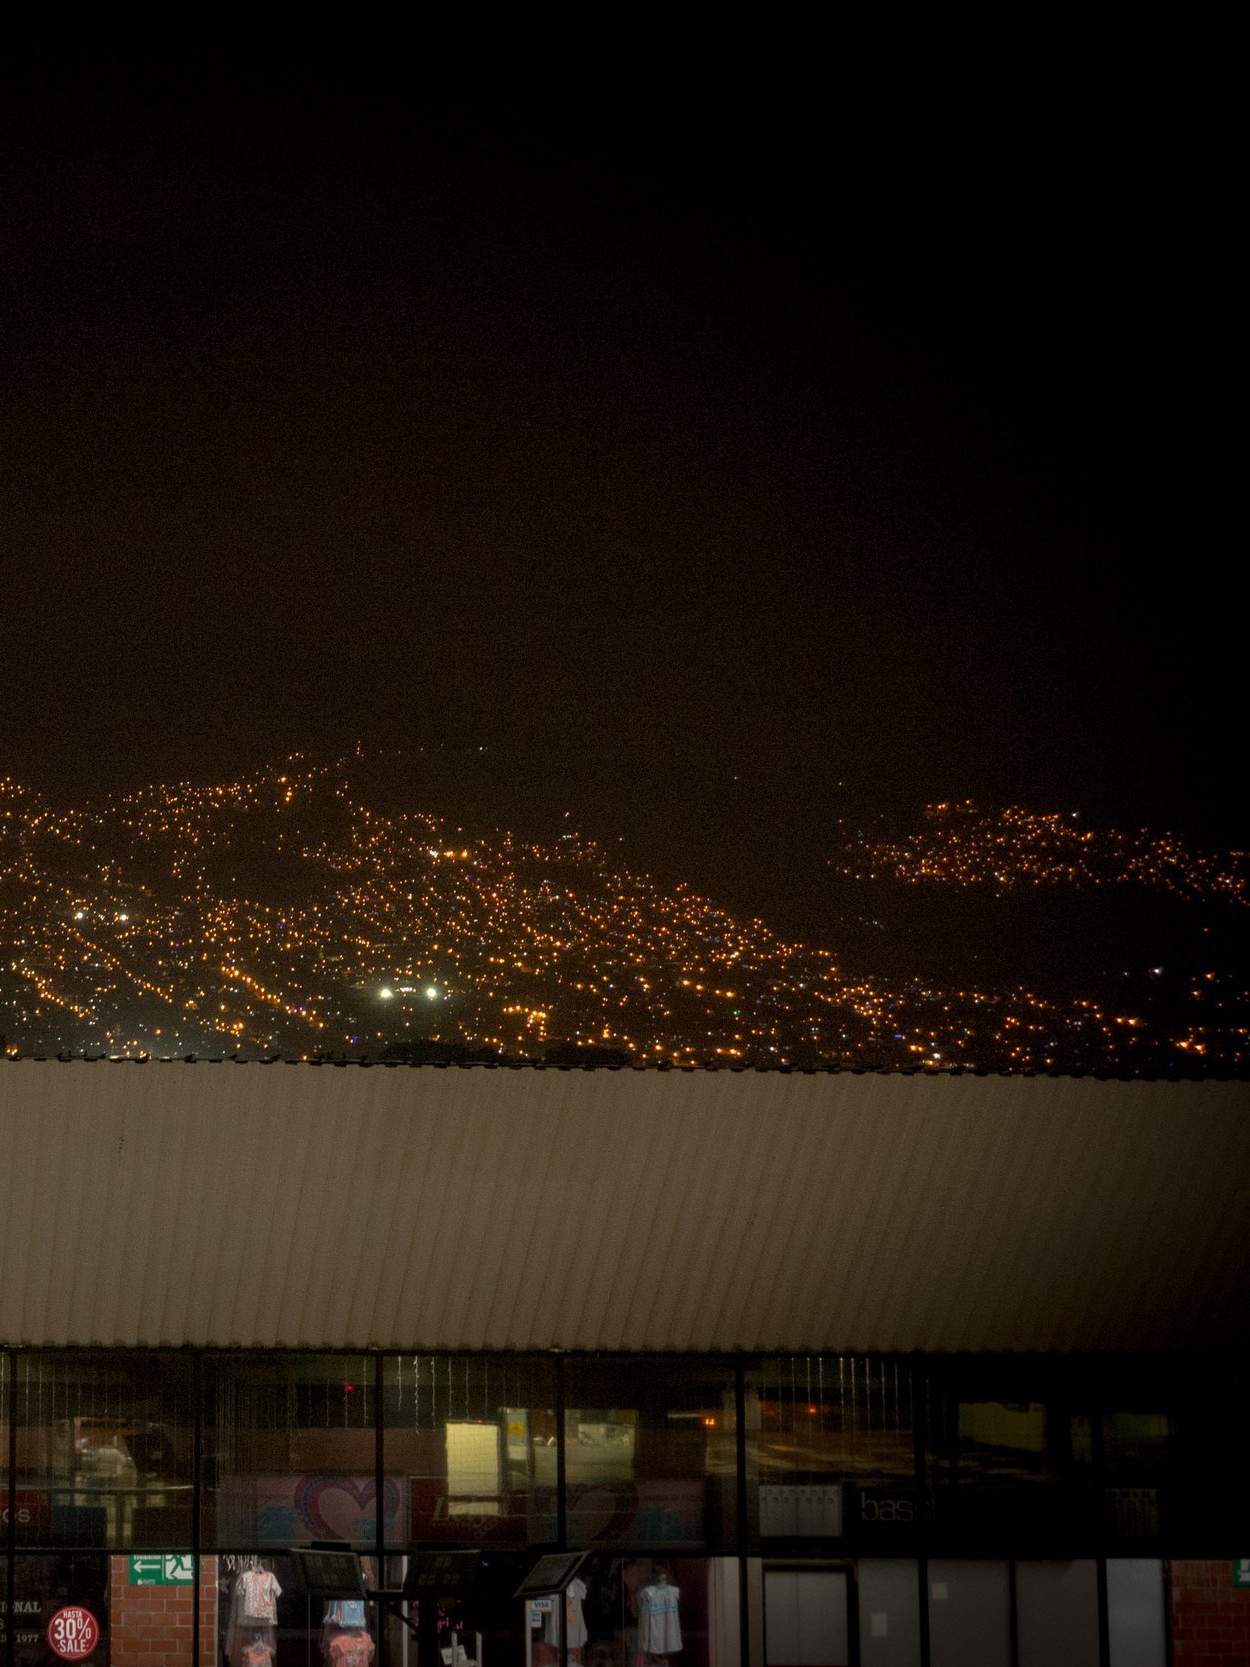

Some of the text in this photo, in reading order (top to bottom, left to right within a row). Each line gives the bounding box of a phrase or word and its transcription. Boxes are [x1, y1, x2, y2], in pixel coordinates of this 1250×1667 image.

[63, 1610, 83, 1619] HASTA
[54, 1617, 92, 1640] 30%
[16, 1634, 39, 1643] 1977
[59, 1639, 87, 1653] SALE
